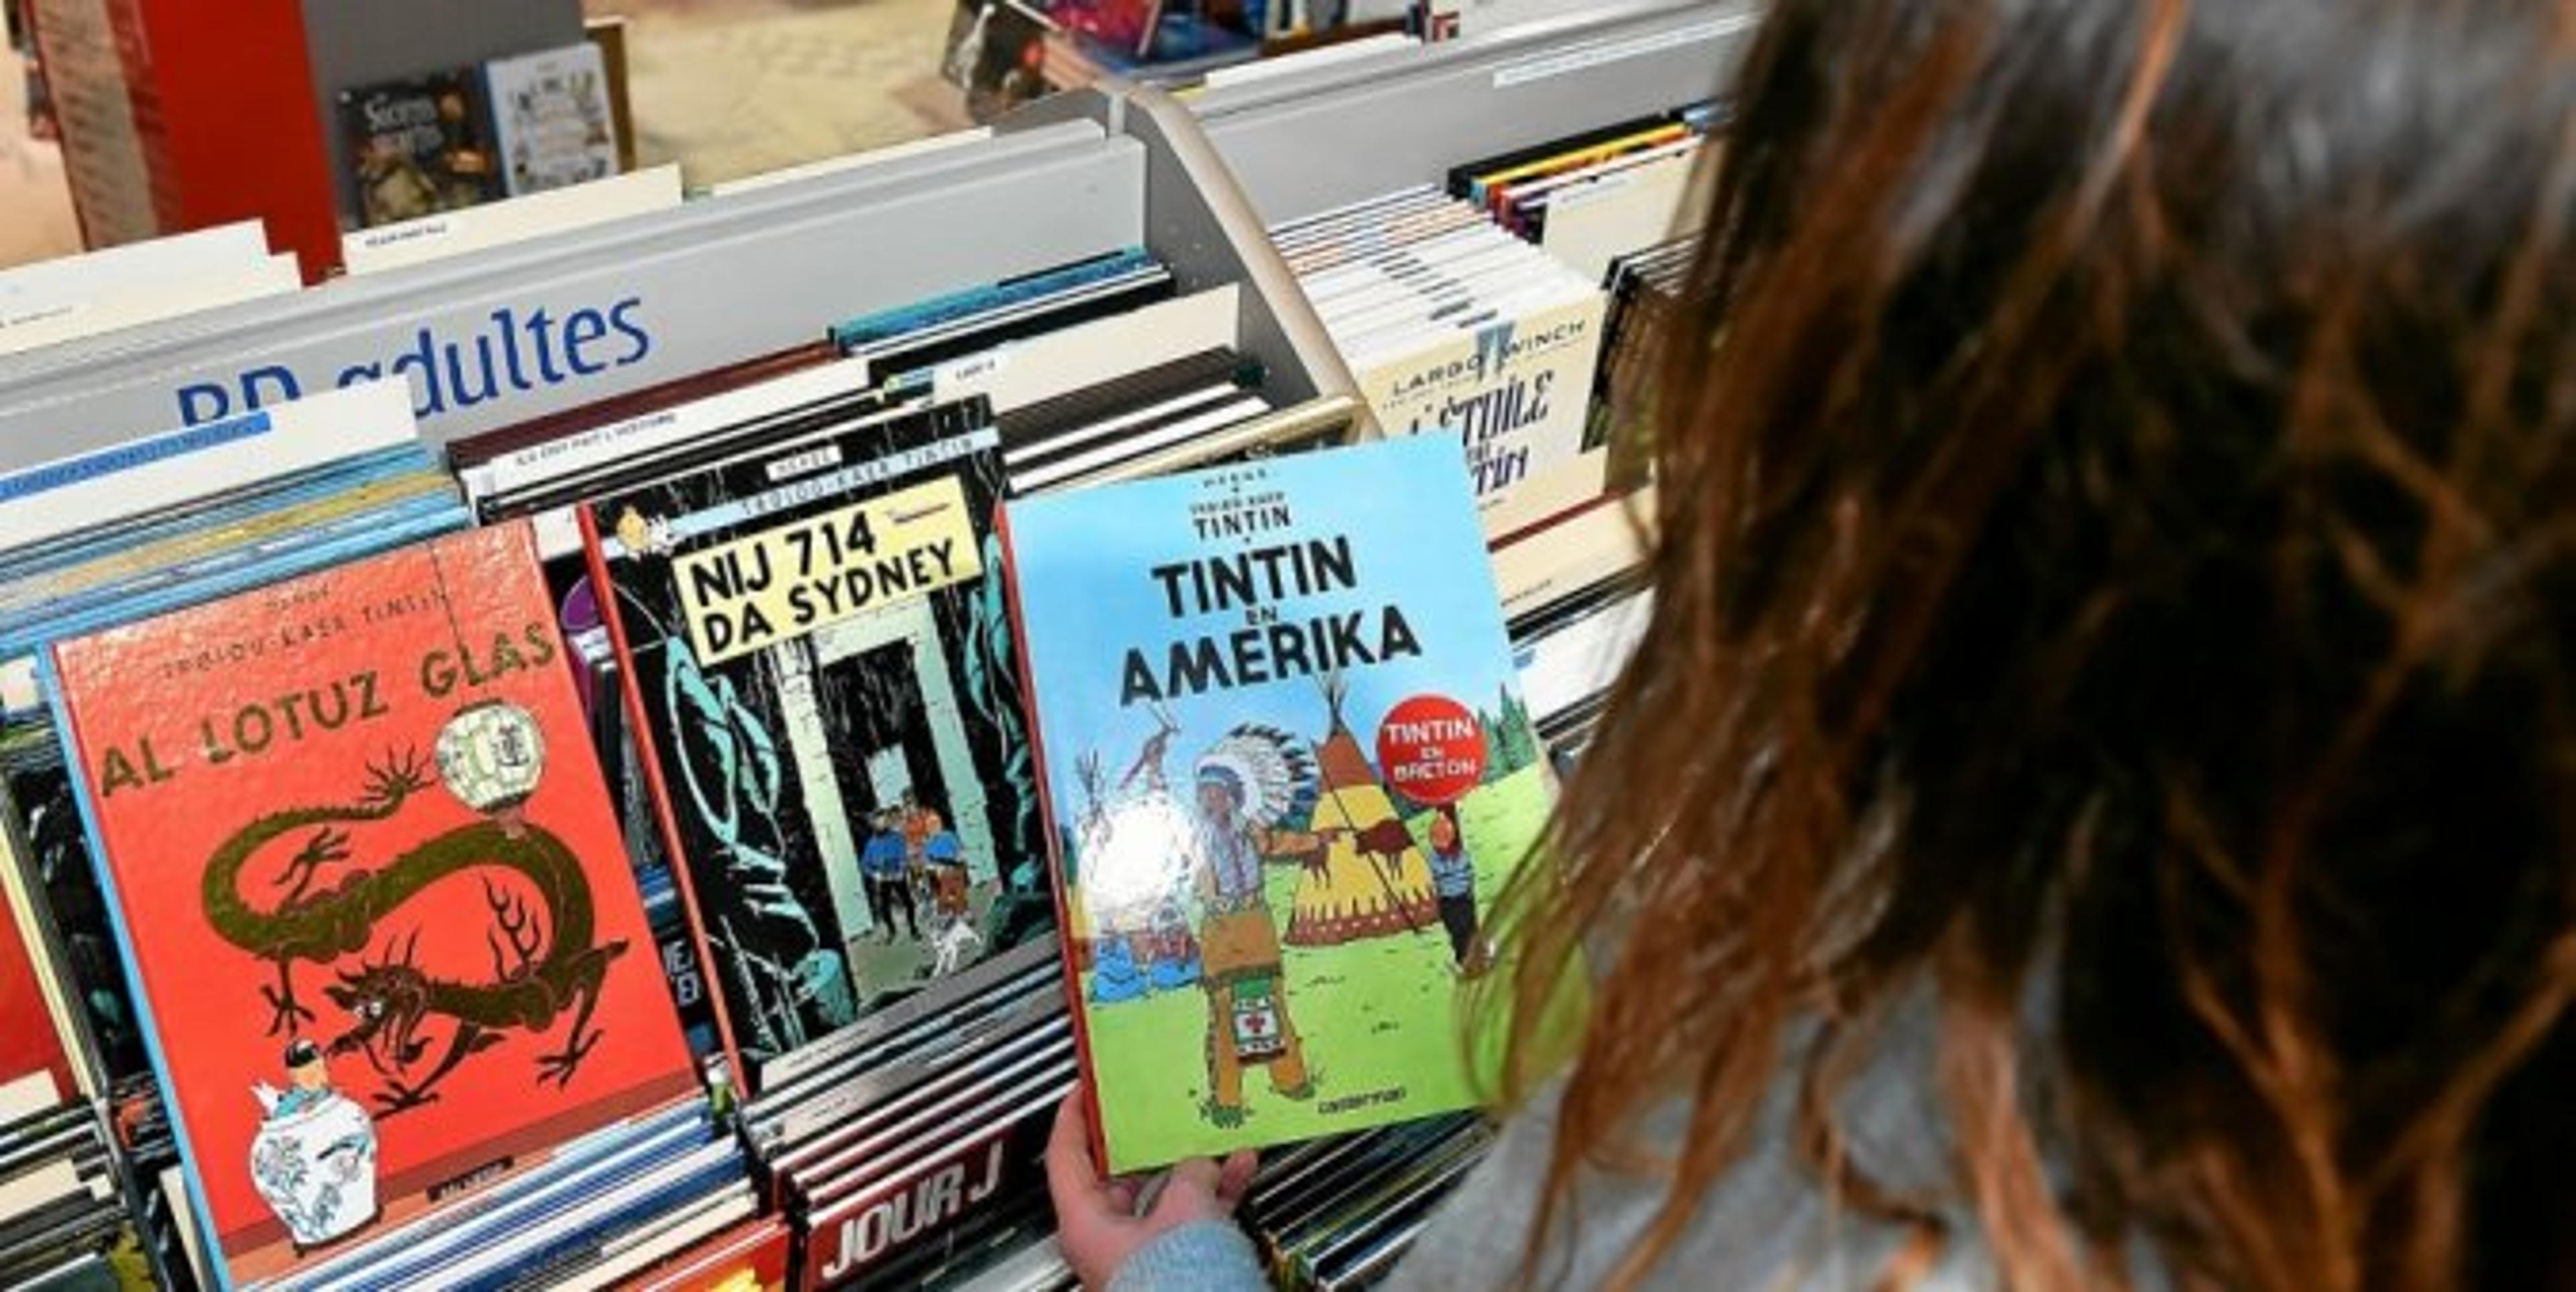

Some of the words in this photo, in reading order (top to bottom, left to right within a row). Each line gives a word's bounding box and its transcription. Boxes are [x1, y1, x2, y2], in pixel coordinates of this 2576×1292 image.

[1393, 354, 1485, 396] LARGO
[1501, 319, 1585, 360] WINCH
[690, 540, 772, 608] NIJ
[785, 513, 877, 577] 714
[1193, 504, 1291, 541] TINTIN
[704, 597, 772, 653] DA
[789, 539, 955, 624] SYDNEY
[1151, 535, 1358, 618] TINTIN
[1245, 606, 1278, 626] EN
[1120, 606, 1423, 706] AMERIKA
[100, 736, 175, 798] AL
[203, 671, 390, 765] LOTUZ
[420, 621, 556, 698] GLAS
[1386, 717, 1475, 746] TINTIN
[1393, 758, 1476, 782] BRETON
[1420, 747, 1444, 760] EN
[823, 1159, 965, 1277] JOUR
[970, 1139, 1004, 1205] J
